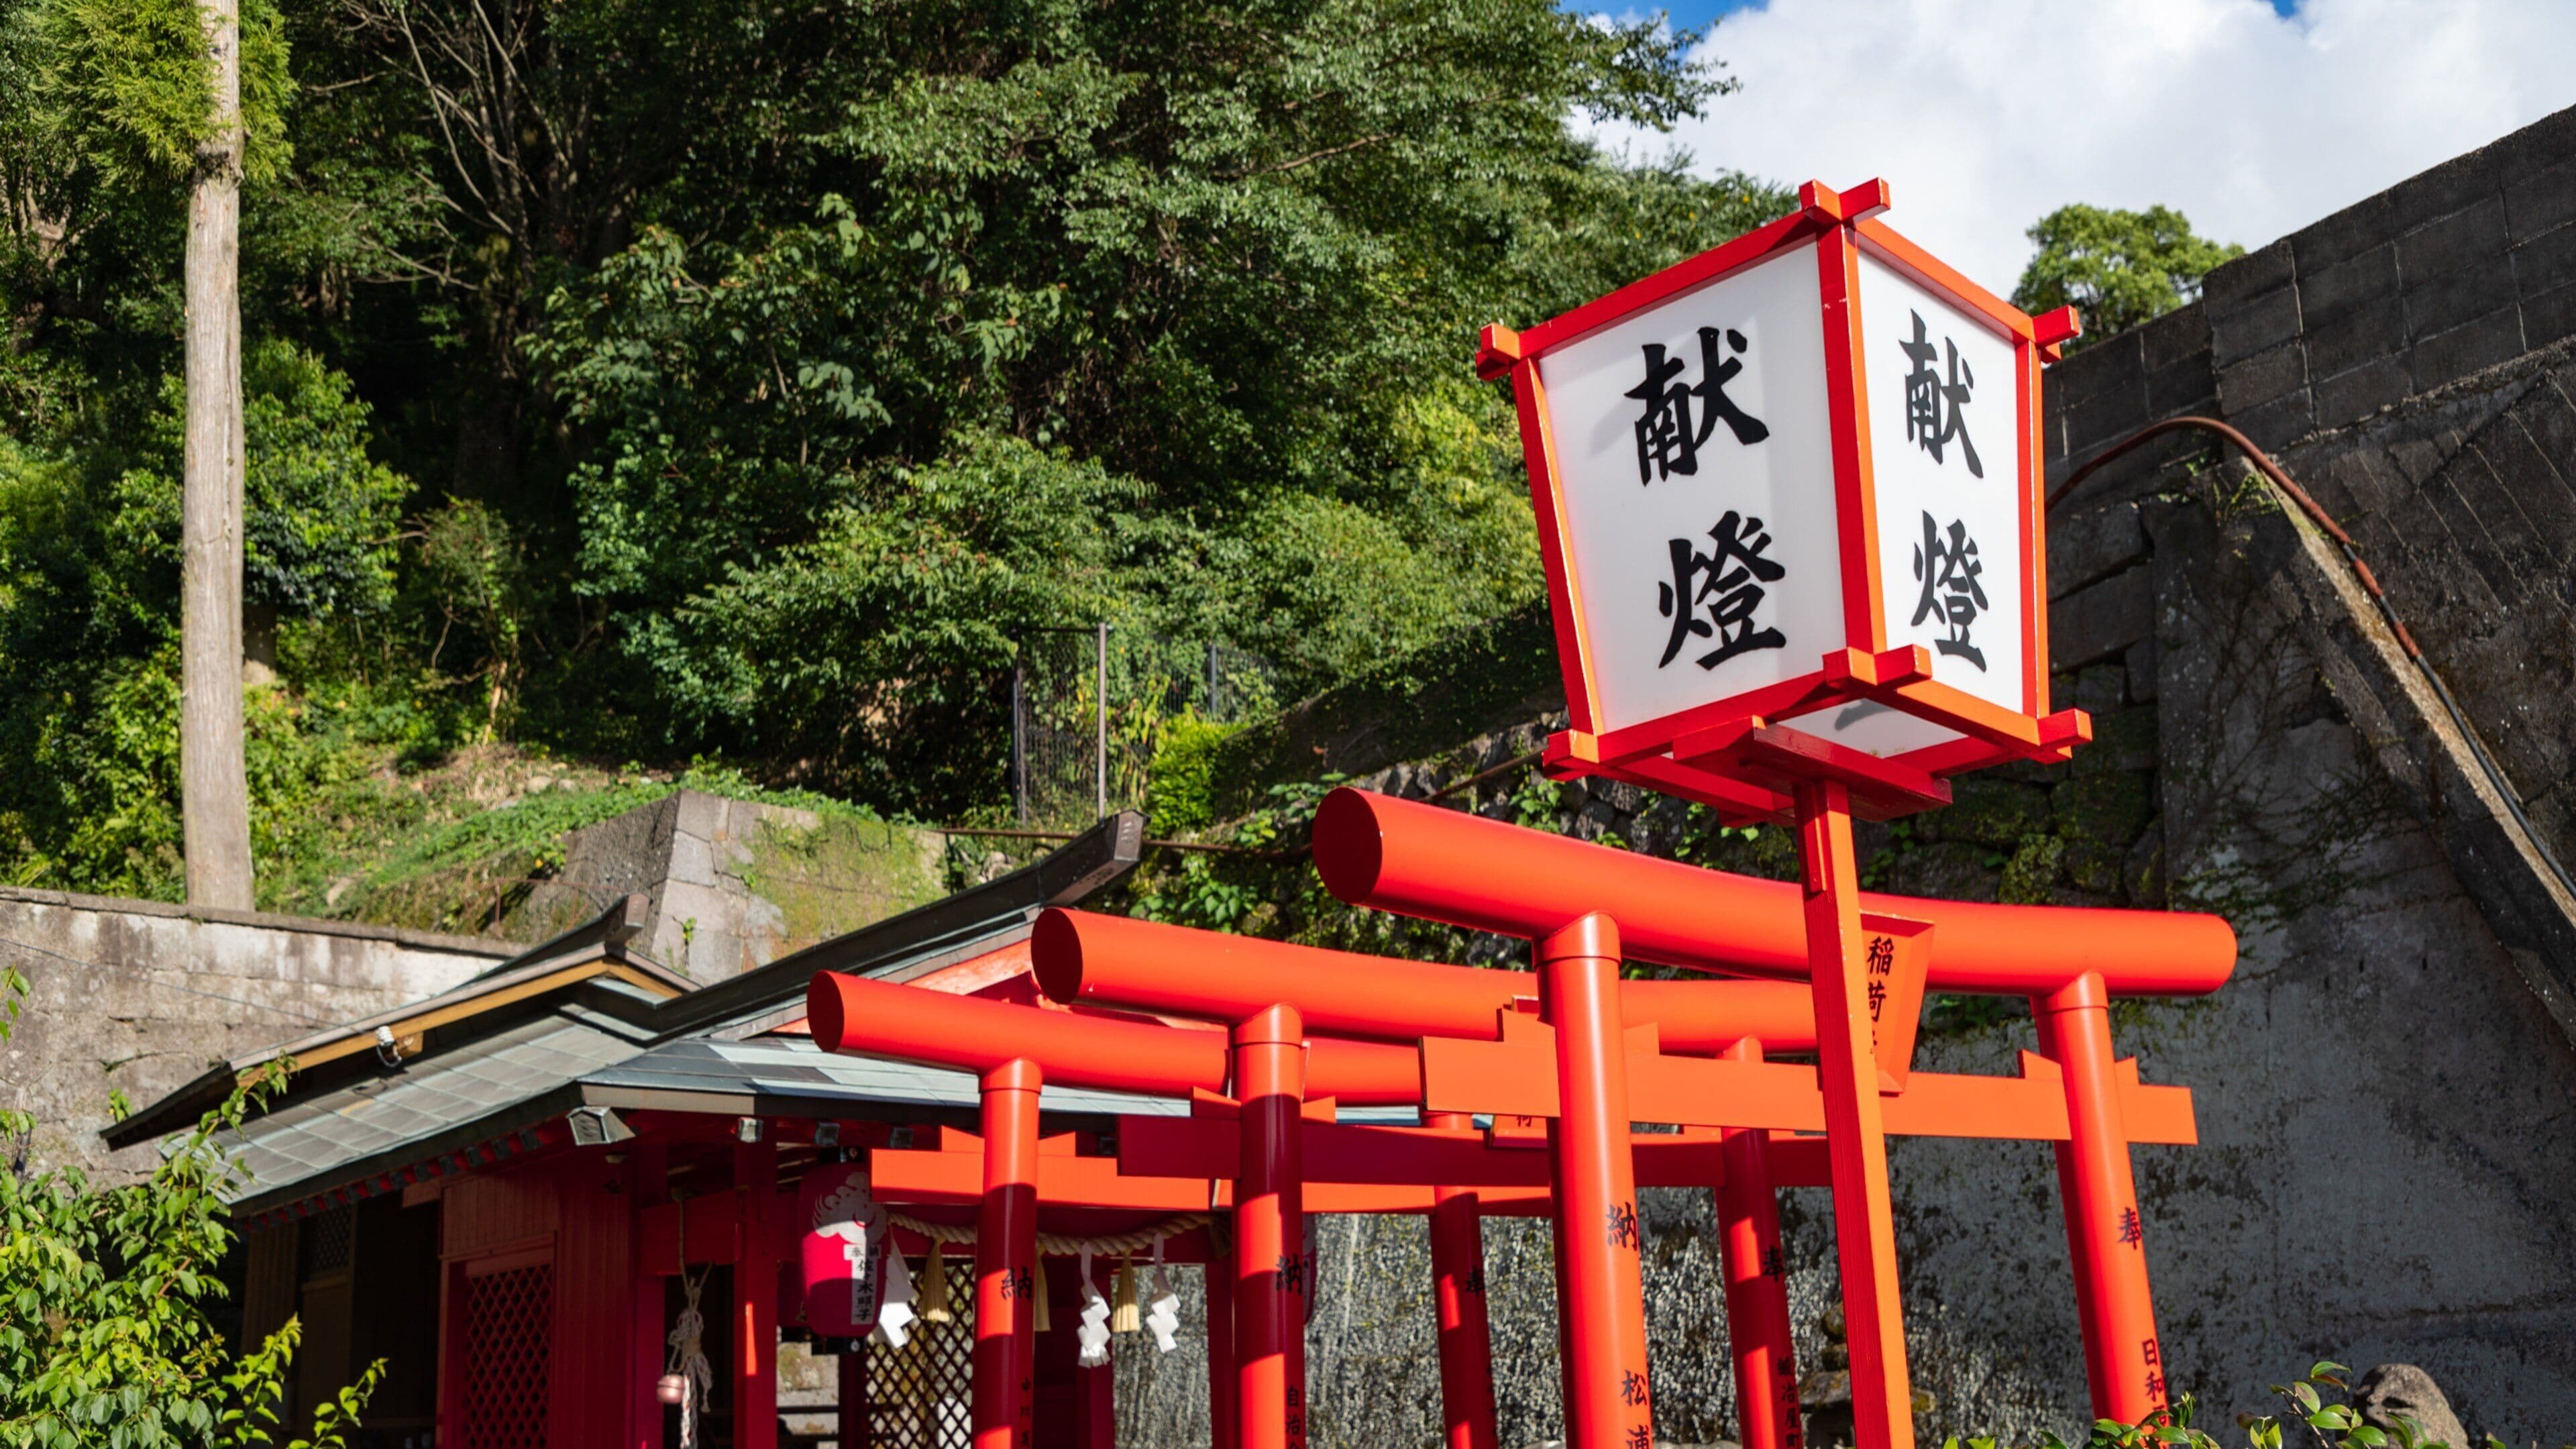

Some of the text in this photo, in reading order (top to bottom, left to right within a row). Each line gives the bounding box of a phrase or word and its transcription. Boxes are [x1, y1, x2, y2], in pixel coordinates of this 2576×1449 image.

[1624, 326, 1786, 671] 献燈
[1898, 308, 1989, 672] 献燈
[1867, 935, 1894, 1048] 稲荷
[1605, 1201, 1638, 1252] 納
[2118, 1207, 2141, 1250] 奉
